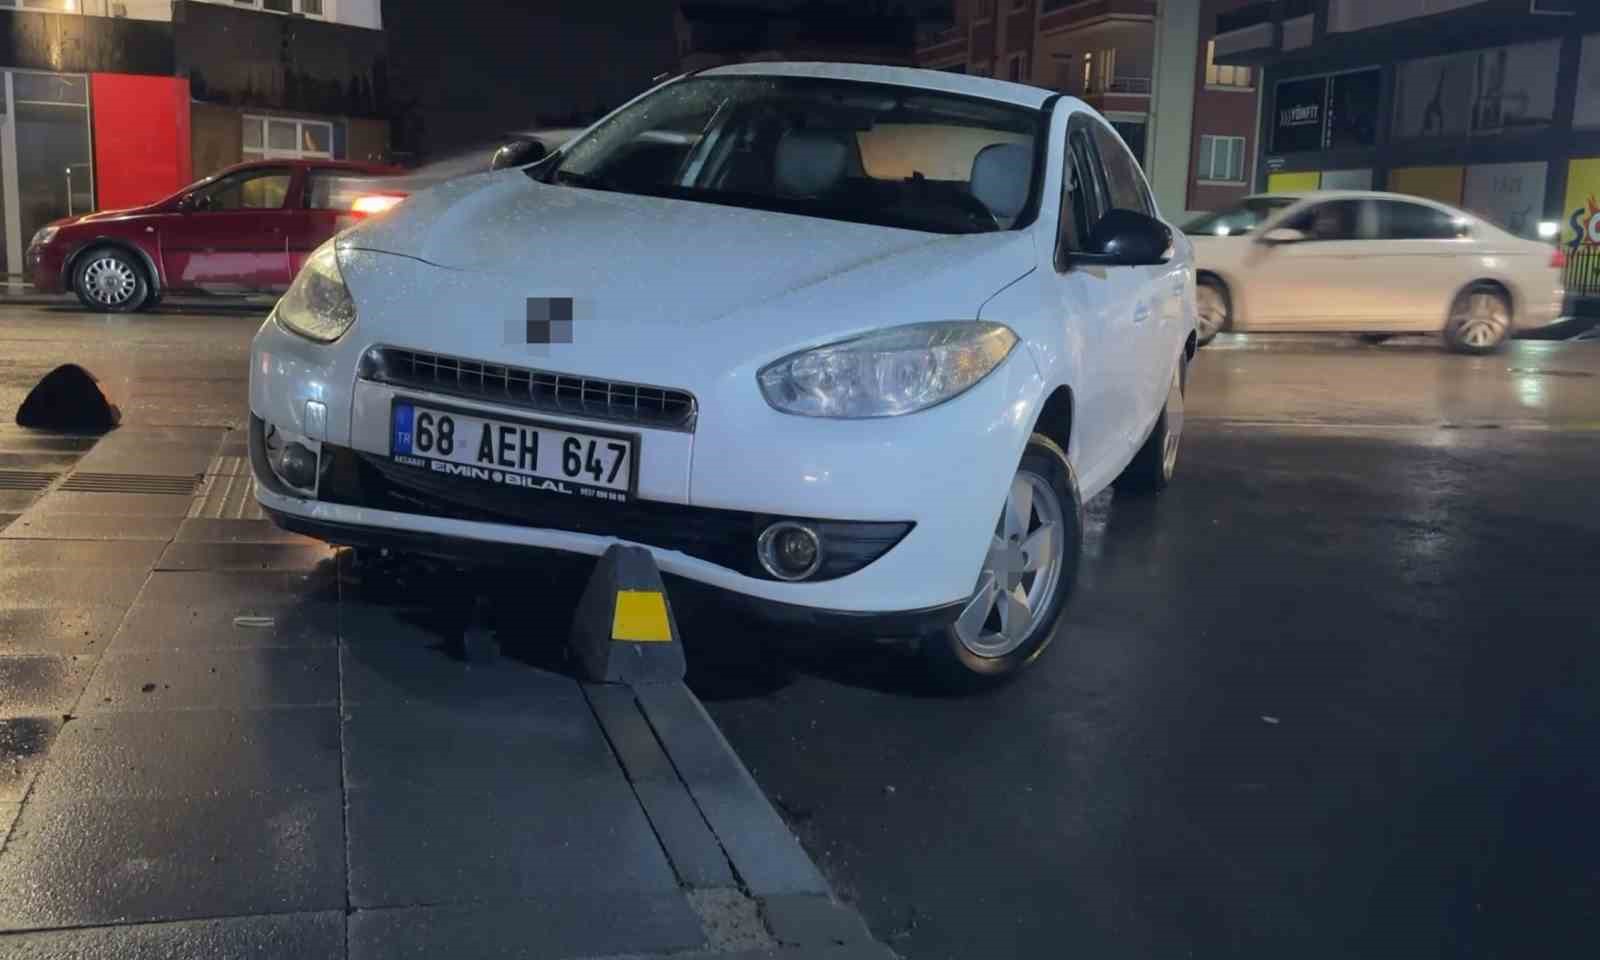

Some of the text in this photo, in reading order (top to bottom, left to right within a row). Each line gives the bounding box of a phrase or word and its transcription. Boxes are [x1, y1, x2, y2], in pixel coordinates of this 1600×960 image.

[398, 431, 411, 447] TR
[416, 412, 627, 483] 68 AEH 647
